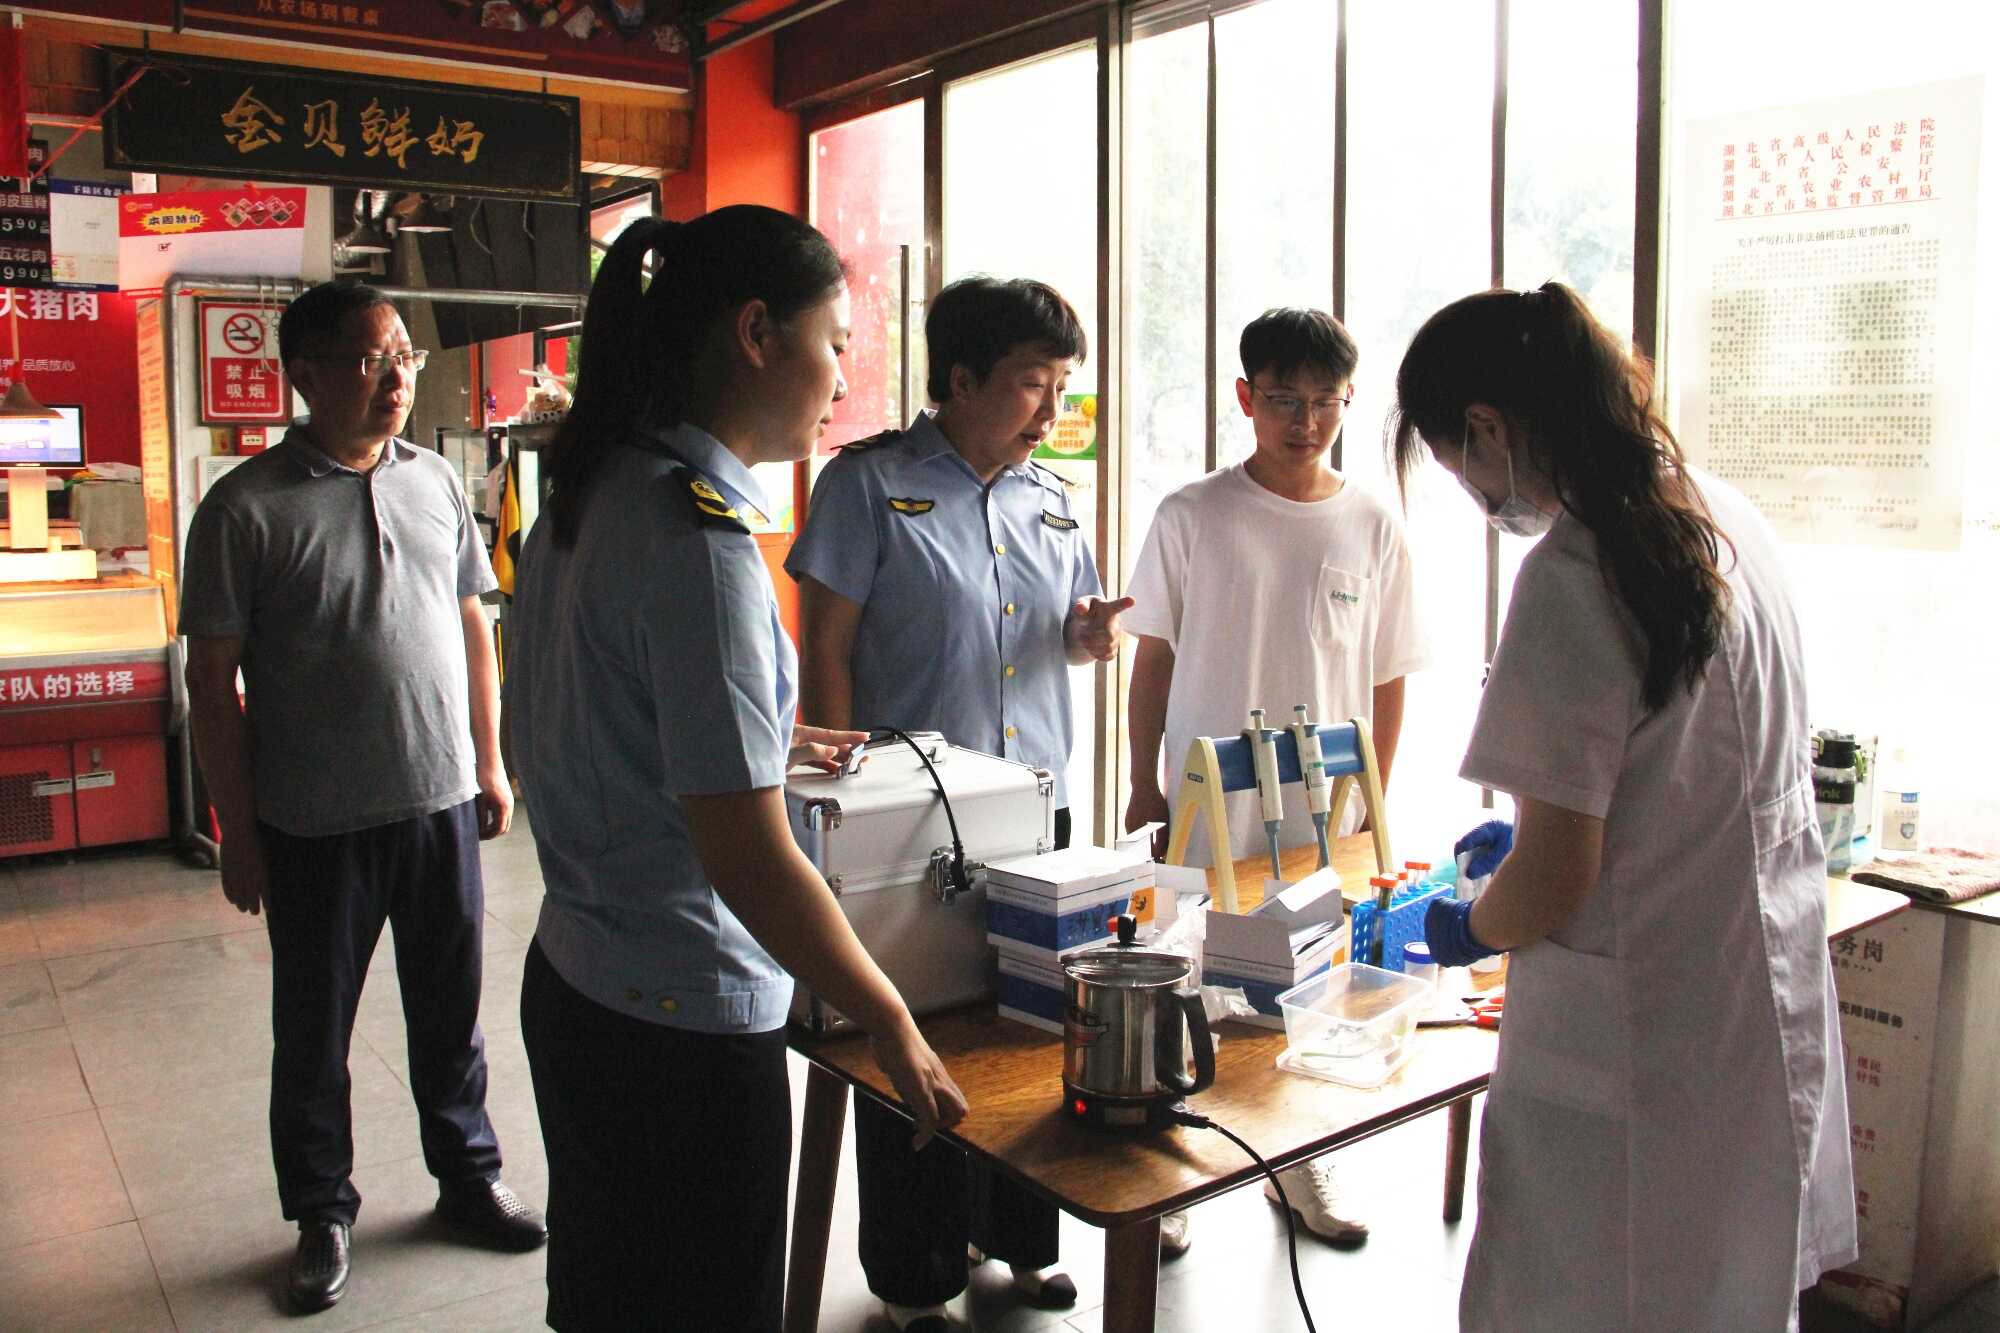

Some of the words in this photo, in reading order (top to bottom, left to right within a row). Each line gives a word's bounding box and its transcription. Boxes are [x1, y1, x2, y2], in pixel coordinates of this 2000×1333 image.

[221, 86, 485, 169] 金贝鲜奶
[1723, 117, 1936, 156] 湖北省高级人民法院
[1723, 133, 1935, 172] 湖北省人民检察院
[1723, 150, 1933, 187] 湖北省公安厅
[1723, 167, 1932, 203] 湖北省农业农村厅
[1723, 183, 1933, 218] 湖北省市场监督管理局
[22, 358, 76, 372] 品质放心
[225, 364, 265, 380] 禁止
[225, 383, 266, 399] 吸烟
